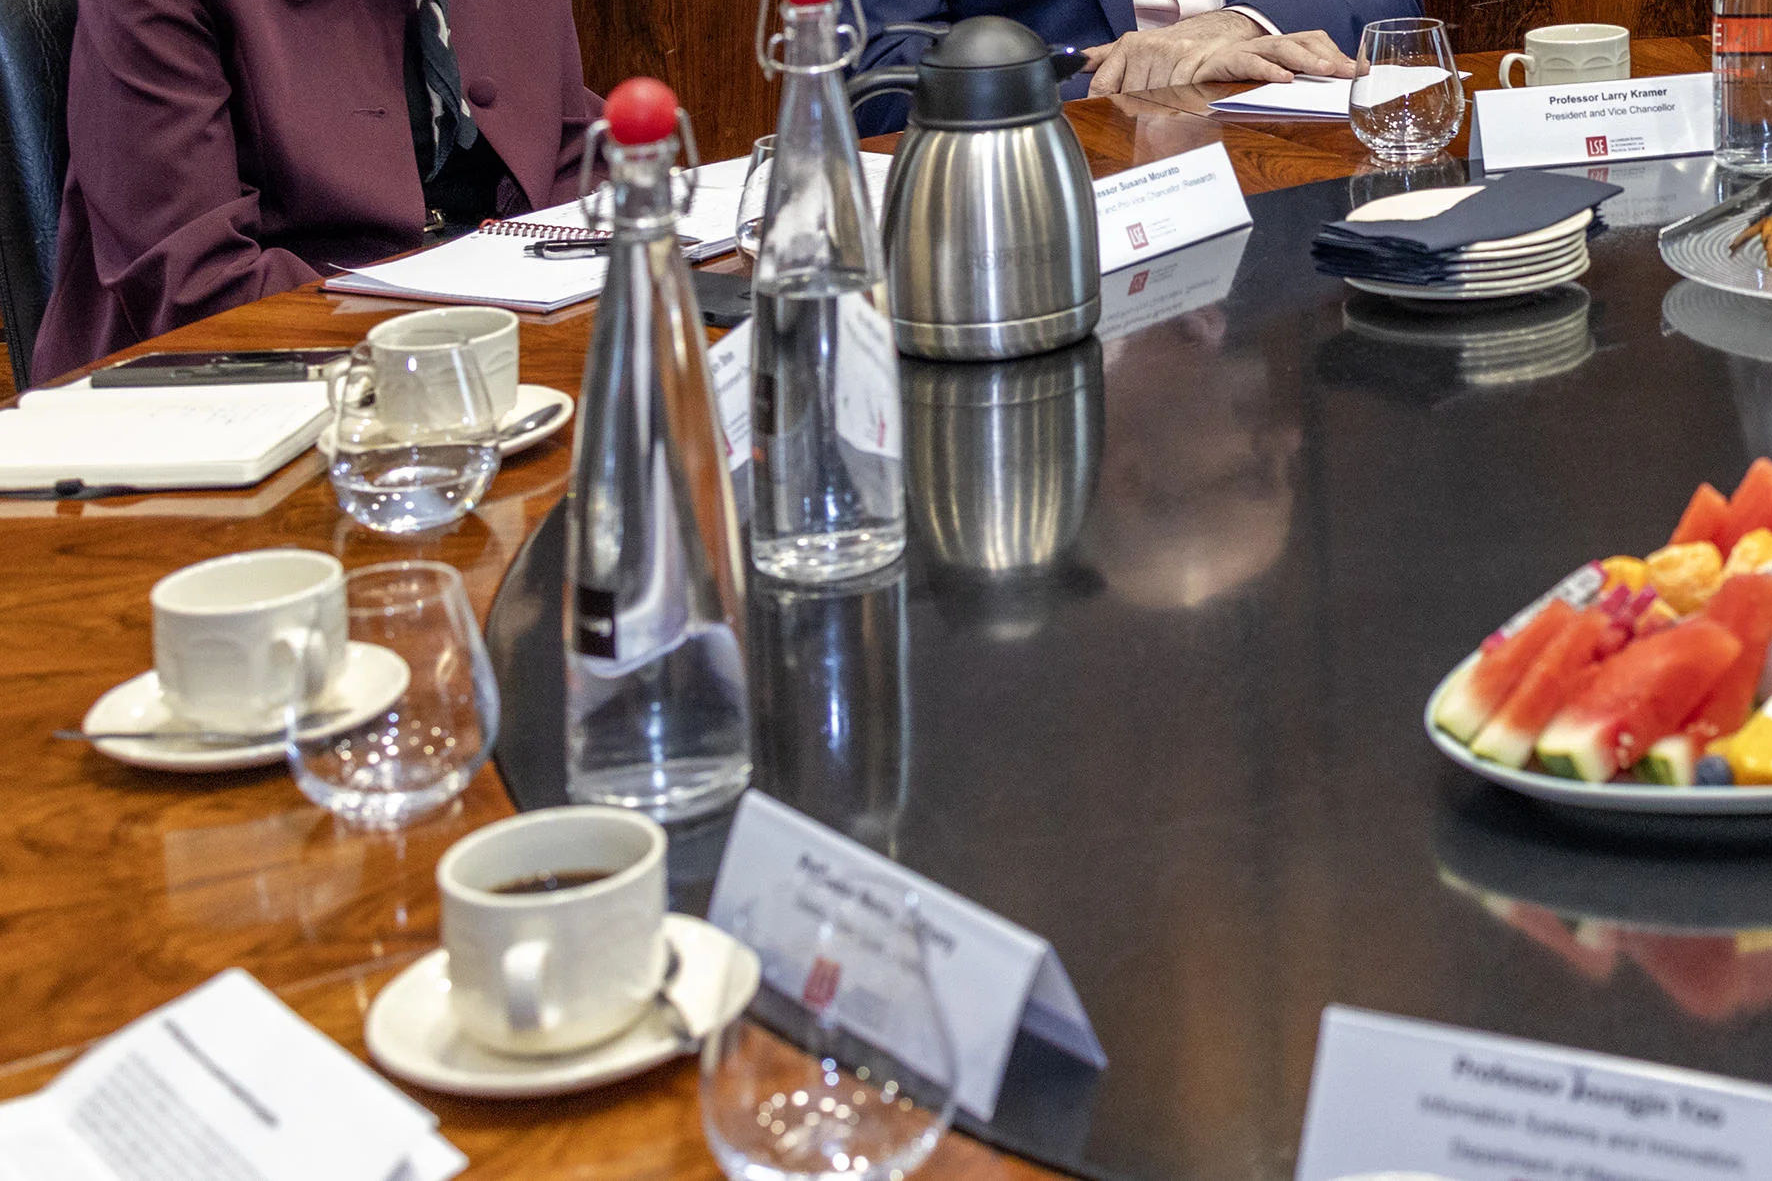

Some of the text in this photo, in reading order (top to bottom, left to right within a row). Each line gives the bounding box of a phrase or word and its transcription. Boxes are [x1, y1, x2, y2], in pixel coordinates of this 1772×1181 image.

[1549, 88, 1668, 105] Professor Larry Kramer
[1545, 103, 1676, 121] President and Vice Chancellor
[1588, 138, 1606, 155] LSE
[1096, 166, 1180, 198] essor Susana Mourato
